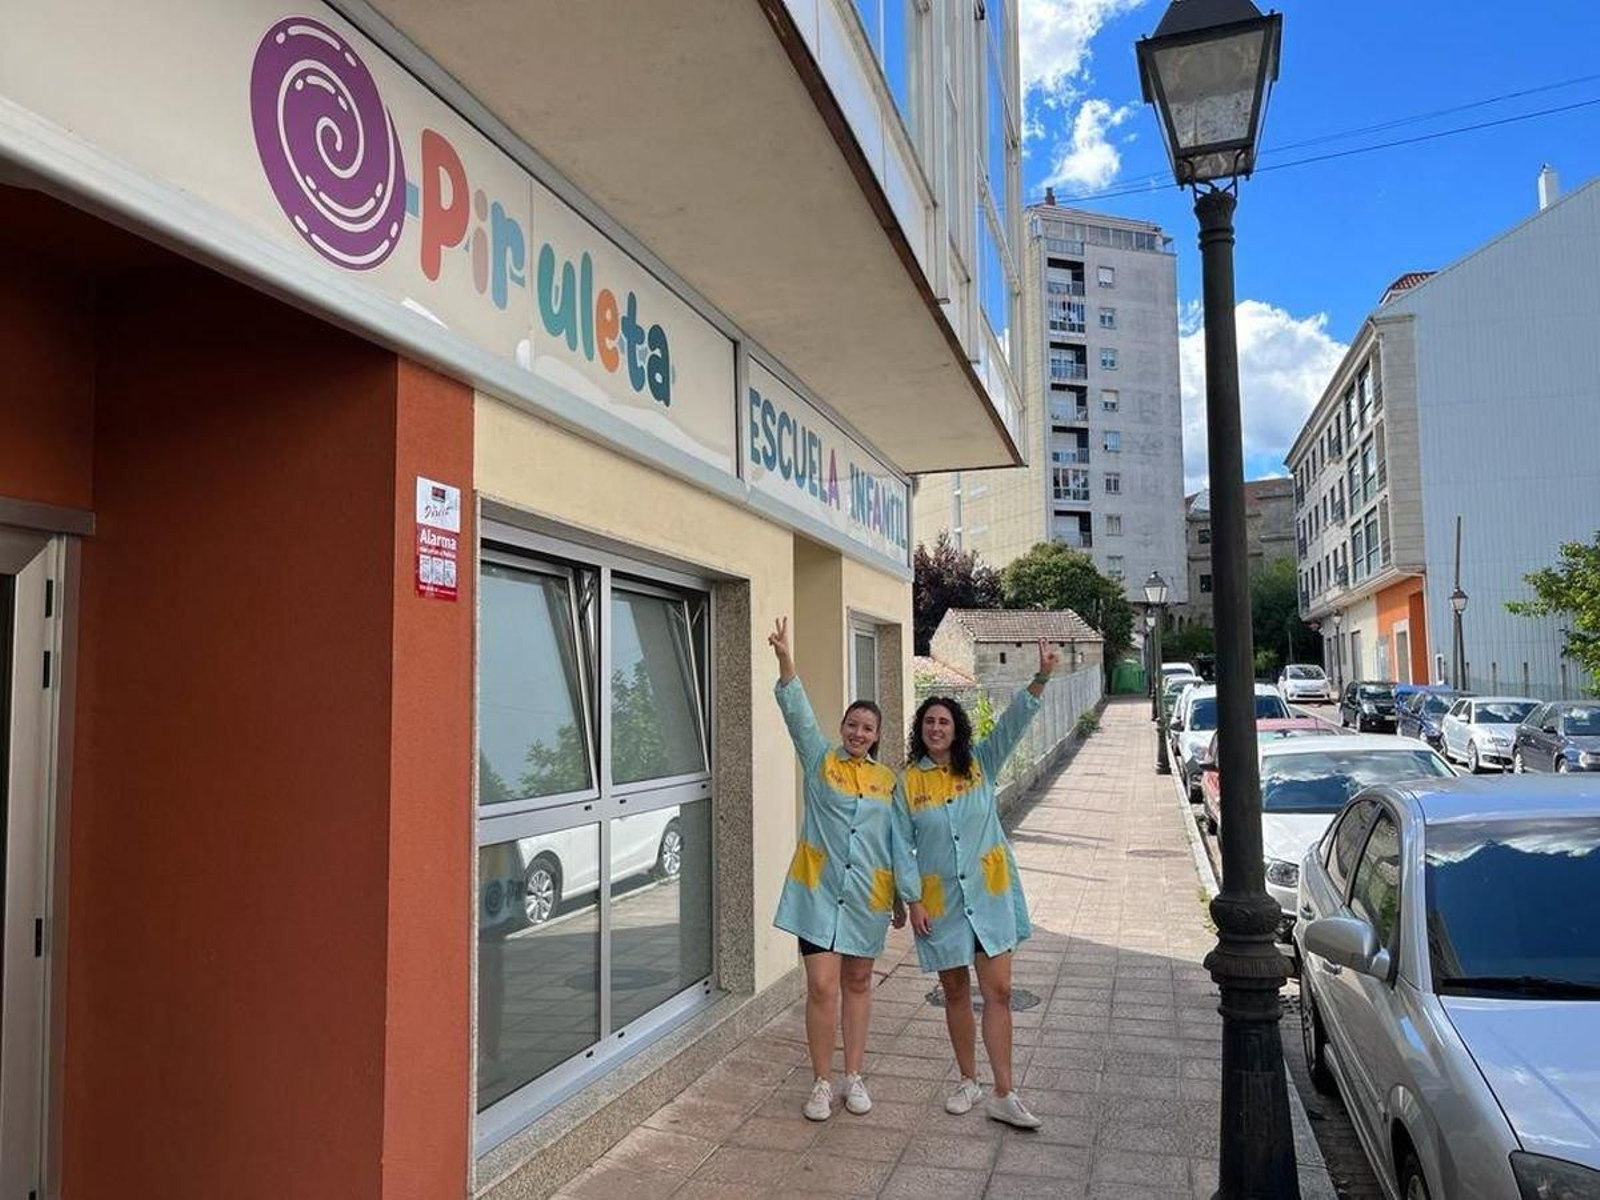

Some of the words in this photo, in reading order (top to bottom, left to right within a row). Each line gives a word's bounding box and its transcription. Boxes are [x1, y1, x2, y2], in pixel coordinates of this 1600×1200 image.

[420, 128, 671, 407] Piruleta
[419, 529, 457, 550] Alarma
[748, 387, 841, 511] ESCUELA
[849, 462, 907, 550] INFANTIL
